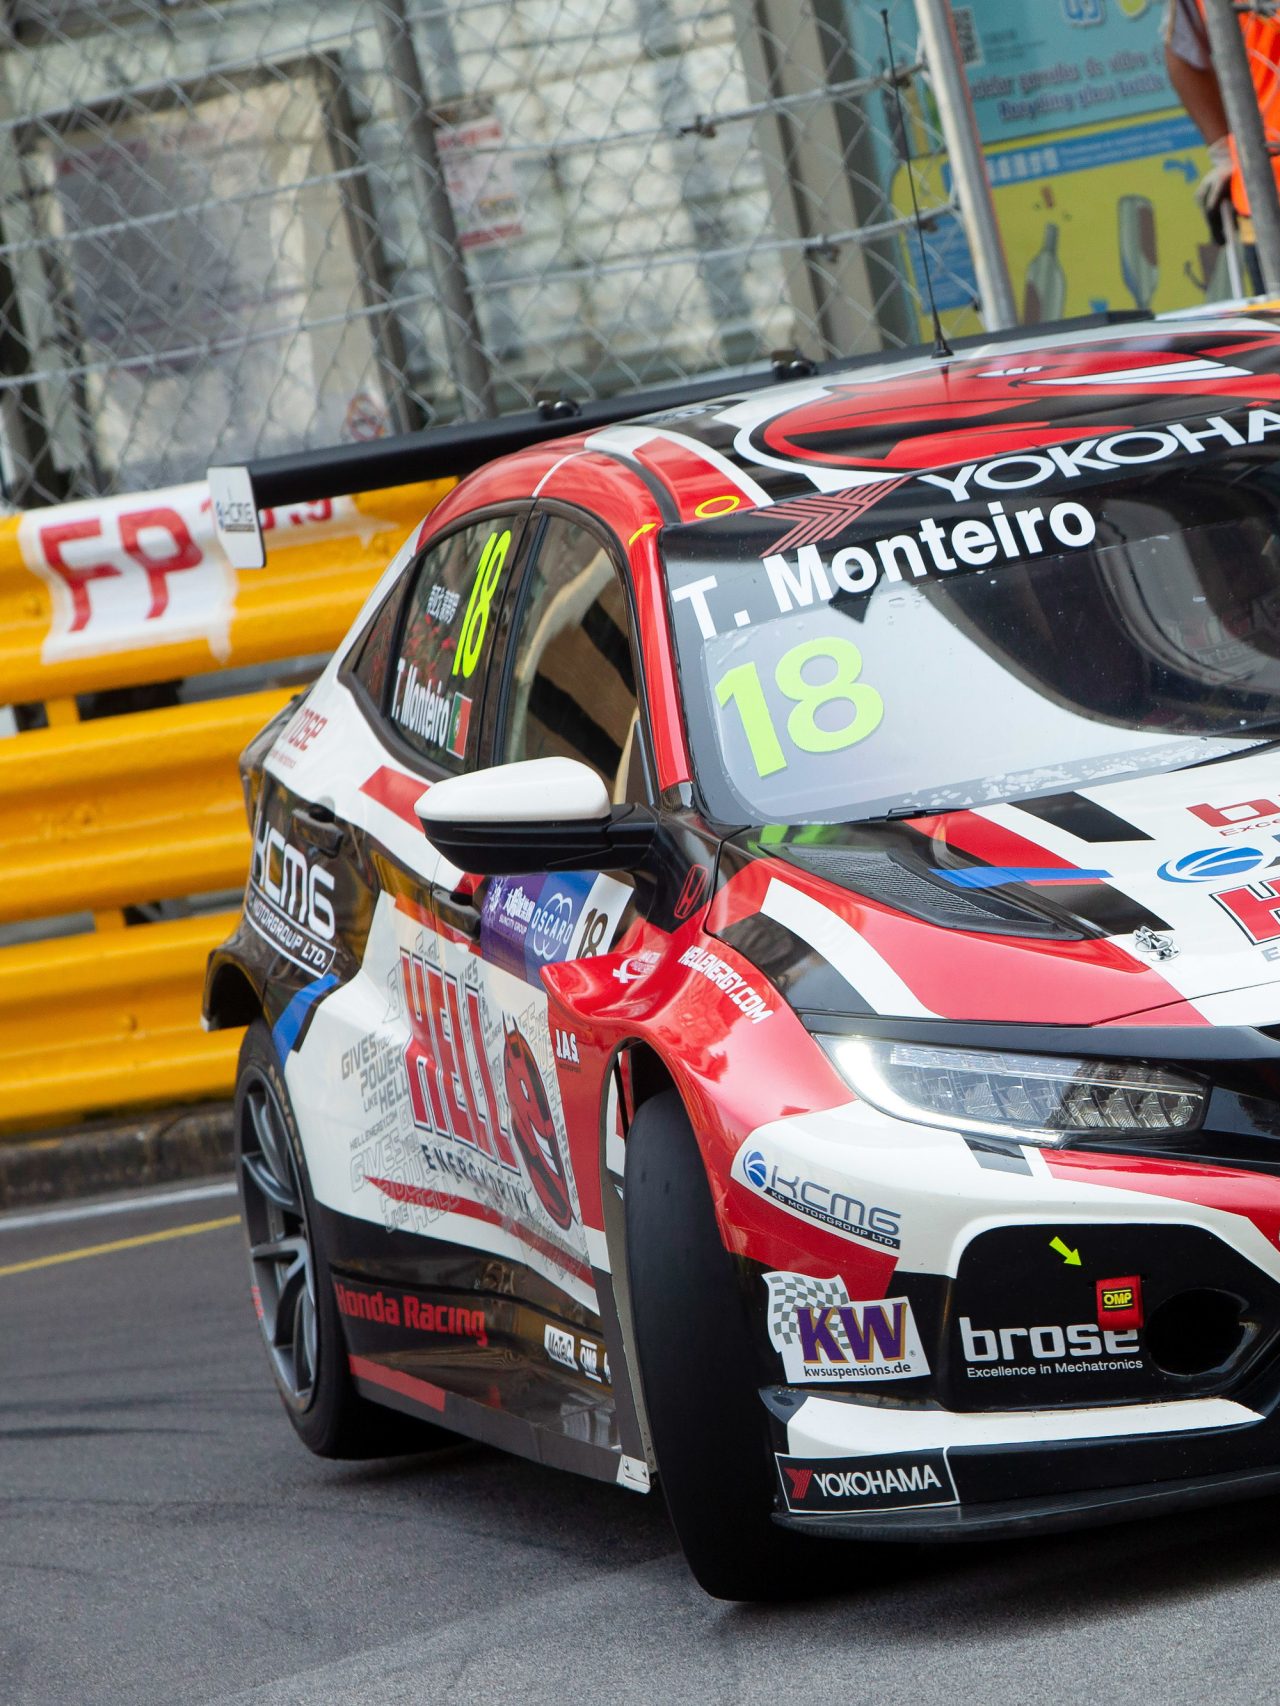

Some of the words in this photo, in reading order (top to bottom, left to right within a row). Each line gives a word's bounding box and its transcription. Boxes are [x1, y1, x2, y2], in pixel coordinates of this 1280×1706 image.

[39, 507, 204, 634] FP
[672, 575, 751, 640] T.
[762, 501, 1097, 614] Monteiro
[452, 529, 512, 679] 18
[400, 663, 451, 748] Monteiro
[714, 636, 885, 778] 18
[531, 907, 574, 945] OSCARO
[576, 908, 609, 959] 18
[300, 940, 327, 969] LTD.
[677, 944, 775, 1025] HELLENERGY.COM
[340, 1031, 377, 1082] GIVES
[359, 1046, 404, 1097] POWER
[771, 1165, 902, 1236] KCMG
[771, 1190, 785, 1203] KC
[787, 1199, 869, 1238] MOTORGROUP
[871, 1231, 898, 1248] LTD.
[334, 1281, 401, 1326] Honda
[402, 1294, 489, 1348] Racing
[1103, 1292, 1133, 1306] OMP
[796, 1302, 908, 1364] KW
[959, 1316, 1140, 1362] brose
[803, 1361, 912, 1380] kwsuspensions.de
[966, 1365, 1037, 1379] Excellence
[1039, 1363, 1052, 1375] in
[1055, 1359, 1144, 1374] Mechatronics
[812, 1464, 943, 1498] YOKOHAMA
